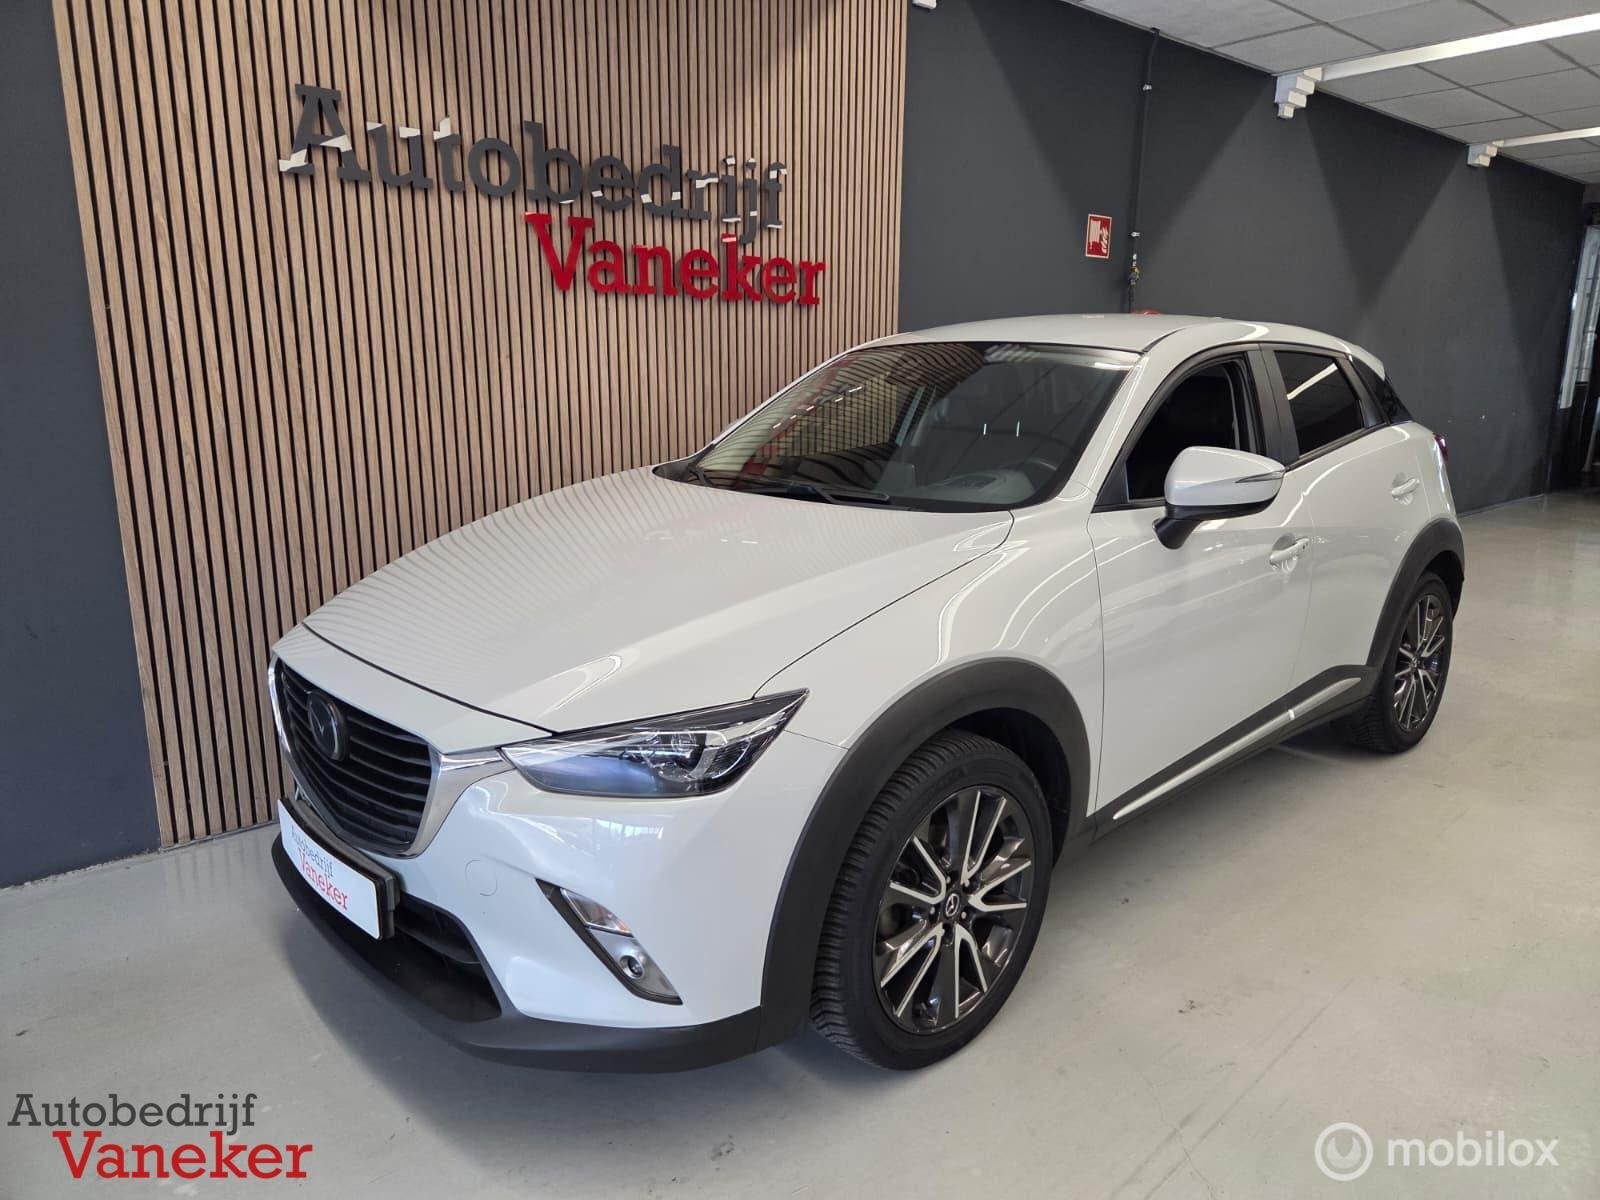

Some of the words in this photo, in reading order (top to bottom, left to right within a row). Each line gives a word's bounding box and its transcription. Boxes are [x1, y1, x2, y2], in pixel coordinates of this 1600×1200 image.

[279, 83, 788, 244] Autobedrijf
[524, 212, 826, 305] Vaneker
[298, 848, 349, 911] Vaneker
